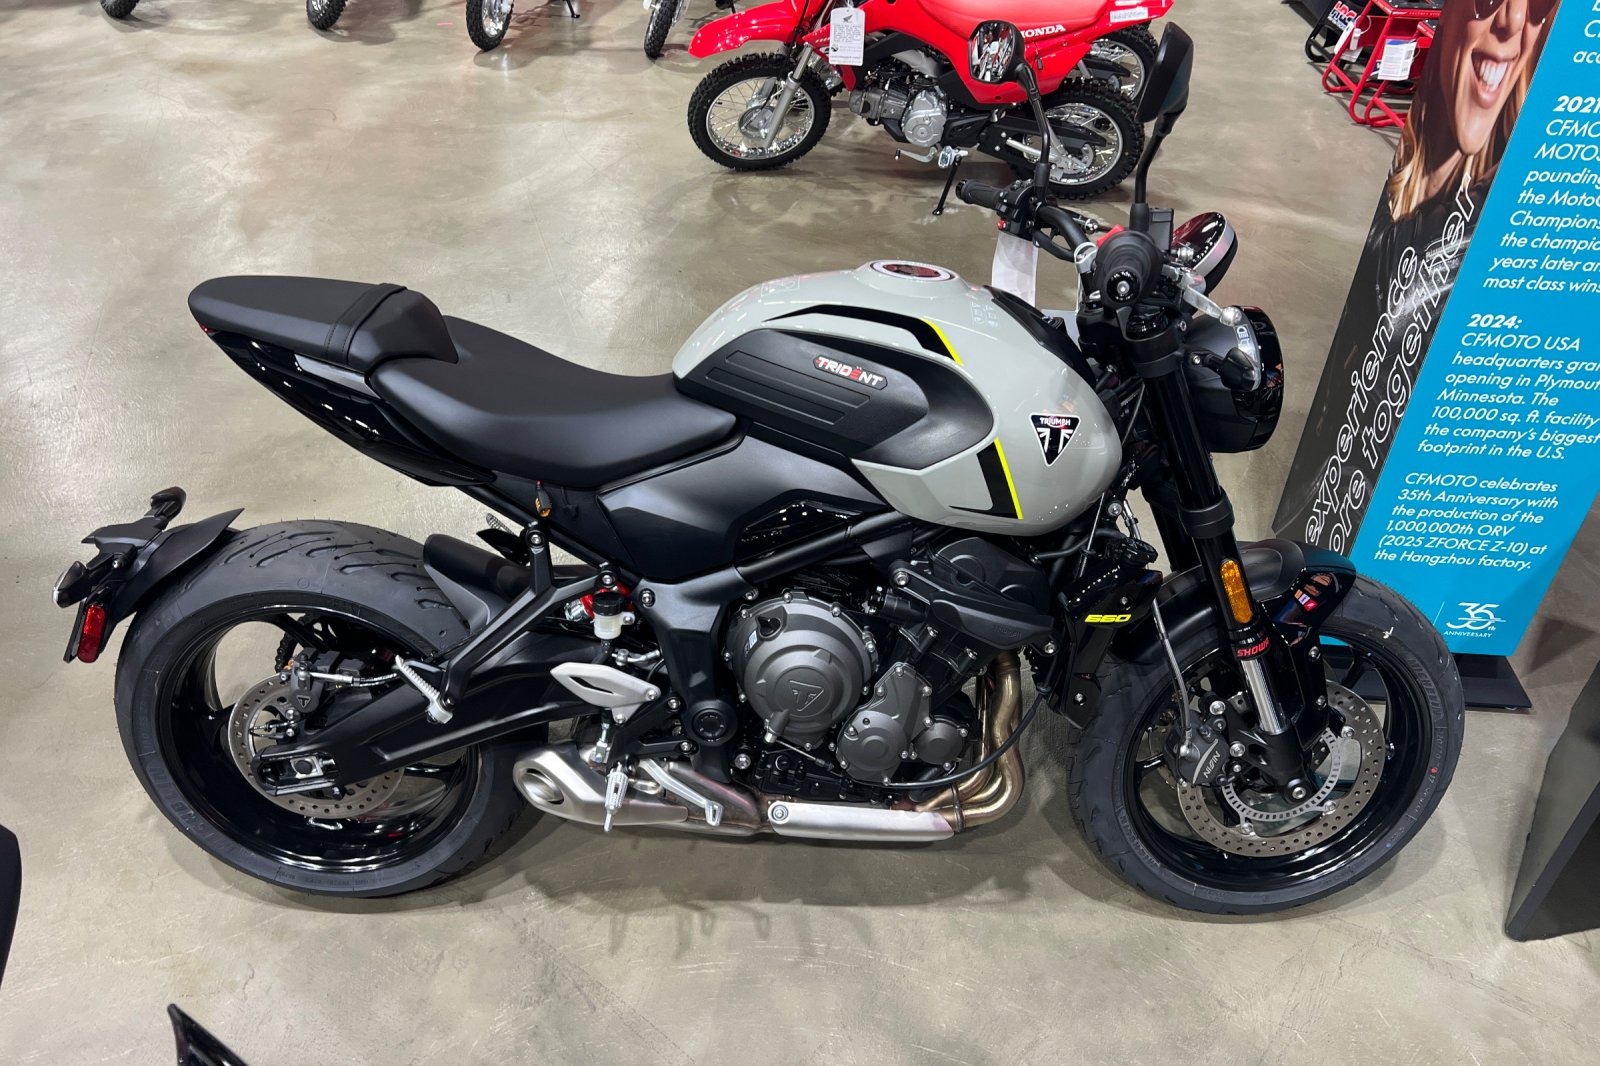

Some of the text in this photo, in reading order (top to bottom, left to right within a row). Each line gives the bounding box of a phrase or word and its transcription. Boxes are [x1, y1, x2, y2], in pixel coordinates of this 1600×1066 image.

[1584, 19, 1600, 38] C
[1533, 143, 1600, 162] MOTO
[1517, 187, 1546, 205] the
[1500, 231, 1528, 248] the
[1489, 257, 1539, 272] years
[1540, 254, 1582, 271] later
[1483, 276, 1526, 289] most
[1525, 275, 1566, 291] class
[1361, 172, 1476, 470] together
[1466, 313, 1523, 329] 2024:
[1461, 332, 1580, 352] CFMOTO USA
[1451, 350, 1565, 371] headquarters
[815, 356, 884, 387] TRIDENT
[1445, 372, 1600, 392] opening in Plymout
[1305, 246, 1417, 547] experience
[1436, 388, 1559, 407] Minnesota. The
[1039, 416, 1071, 429] TRIUMPH
[1431, 405, 1600, 430] 100,000 sq. ft. facility
[1424, 422, 1600, 447] the company's biggest
[1417, 439, 1565, 459] footprint in the U.S.
[1405, 472, 1558, 493] CFMOTO celebrates
[1397, 488, 1559, 510] 35th Anniversary with
[1391, 503, 1544, 524] the production of the
[1386, 519, 1516, 537] 1,000,000th ORV
[1378, 534, 1547, 556] (2025 ZFORCE Z-10) at
[1374, 549, 1531, 571] the Hangzhou factory.
[1084, 614, 1132, 623] 660
[1443, 630, 1492, 638] ANNIVERSARY
